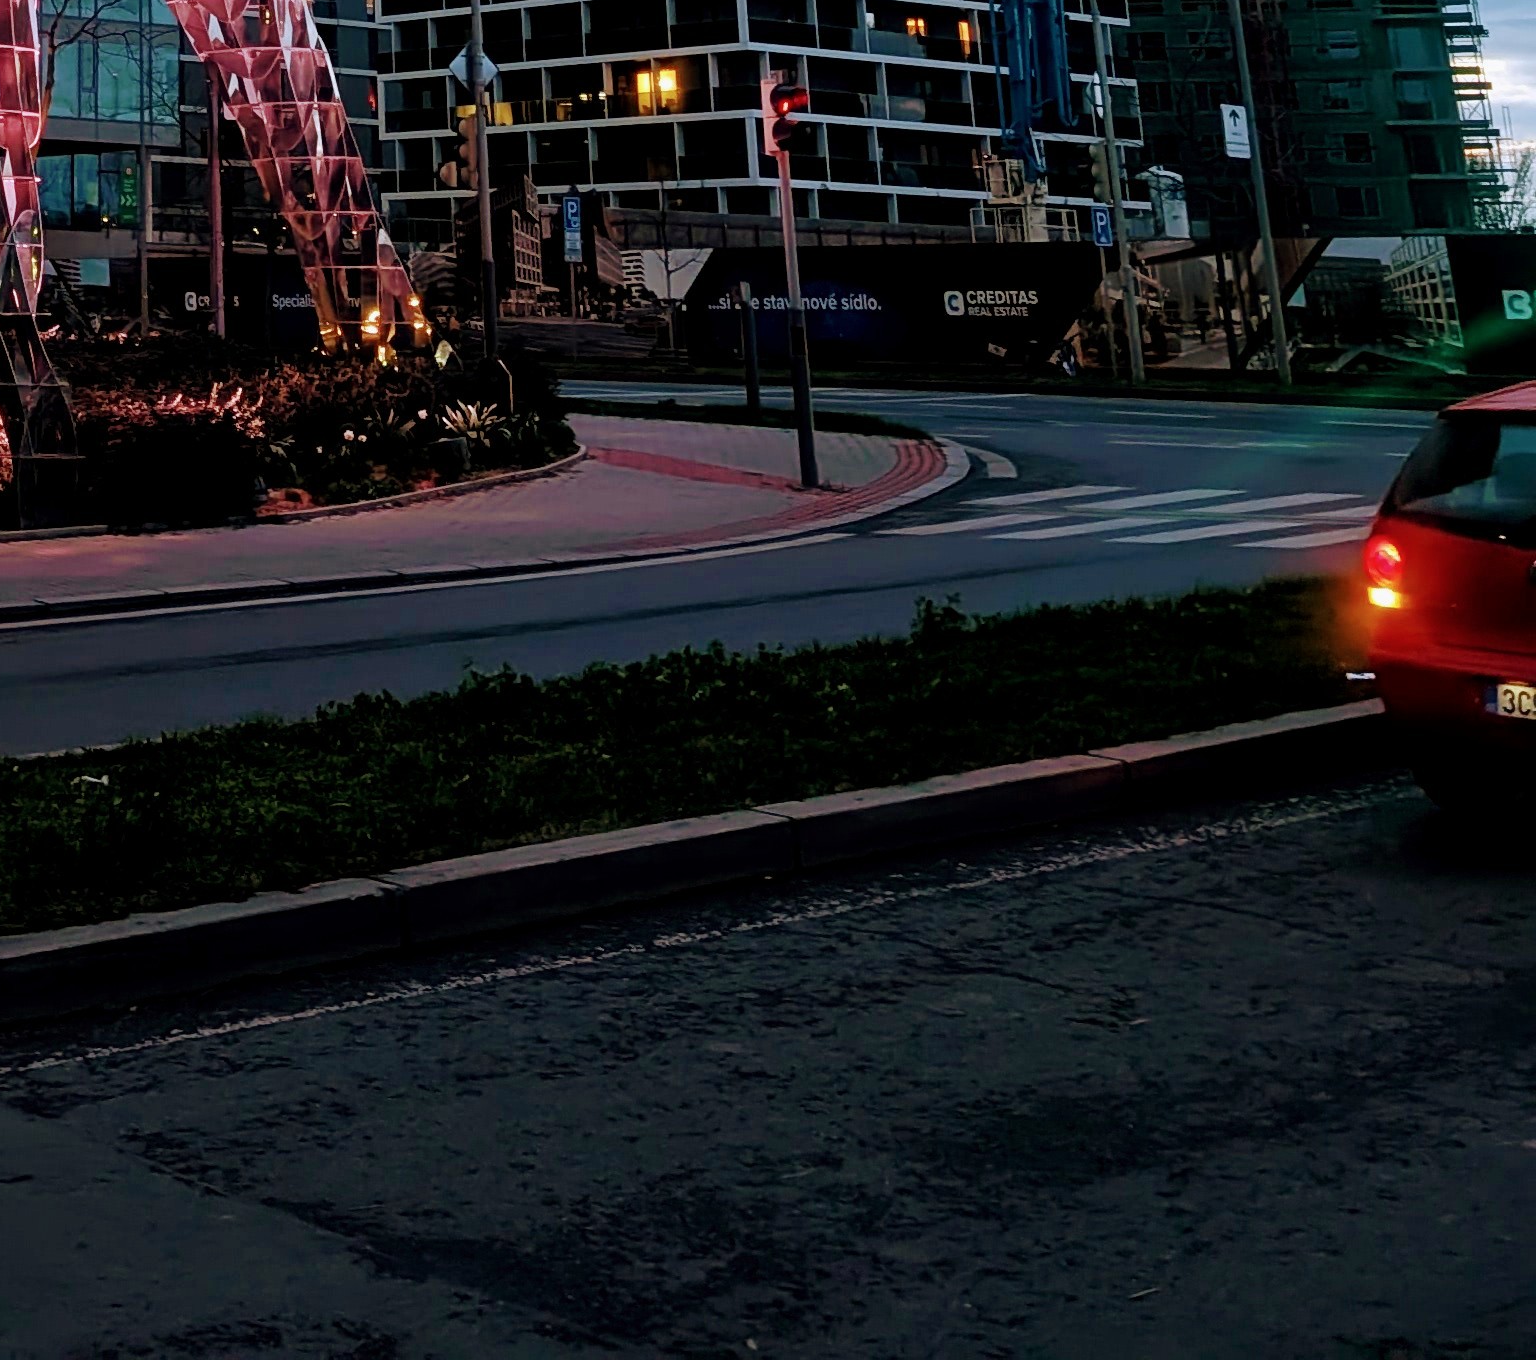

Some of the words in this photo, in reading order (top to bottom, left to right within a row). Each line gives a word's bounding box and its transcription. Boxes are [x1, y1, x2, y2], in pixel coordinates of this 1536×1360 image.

[1096, 211, 1107, 234] P
[841, 293, 882, 311] sídlo.
[966, 290, 1039, 304] CREDITAS
[968, 306, 992, 316] REAL
[994, 306, 1028, 316] ESTATE
